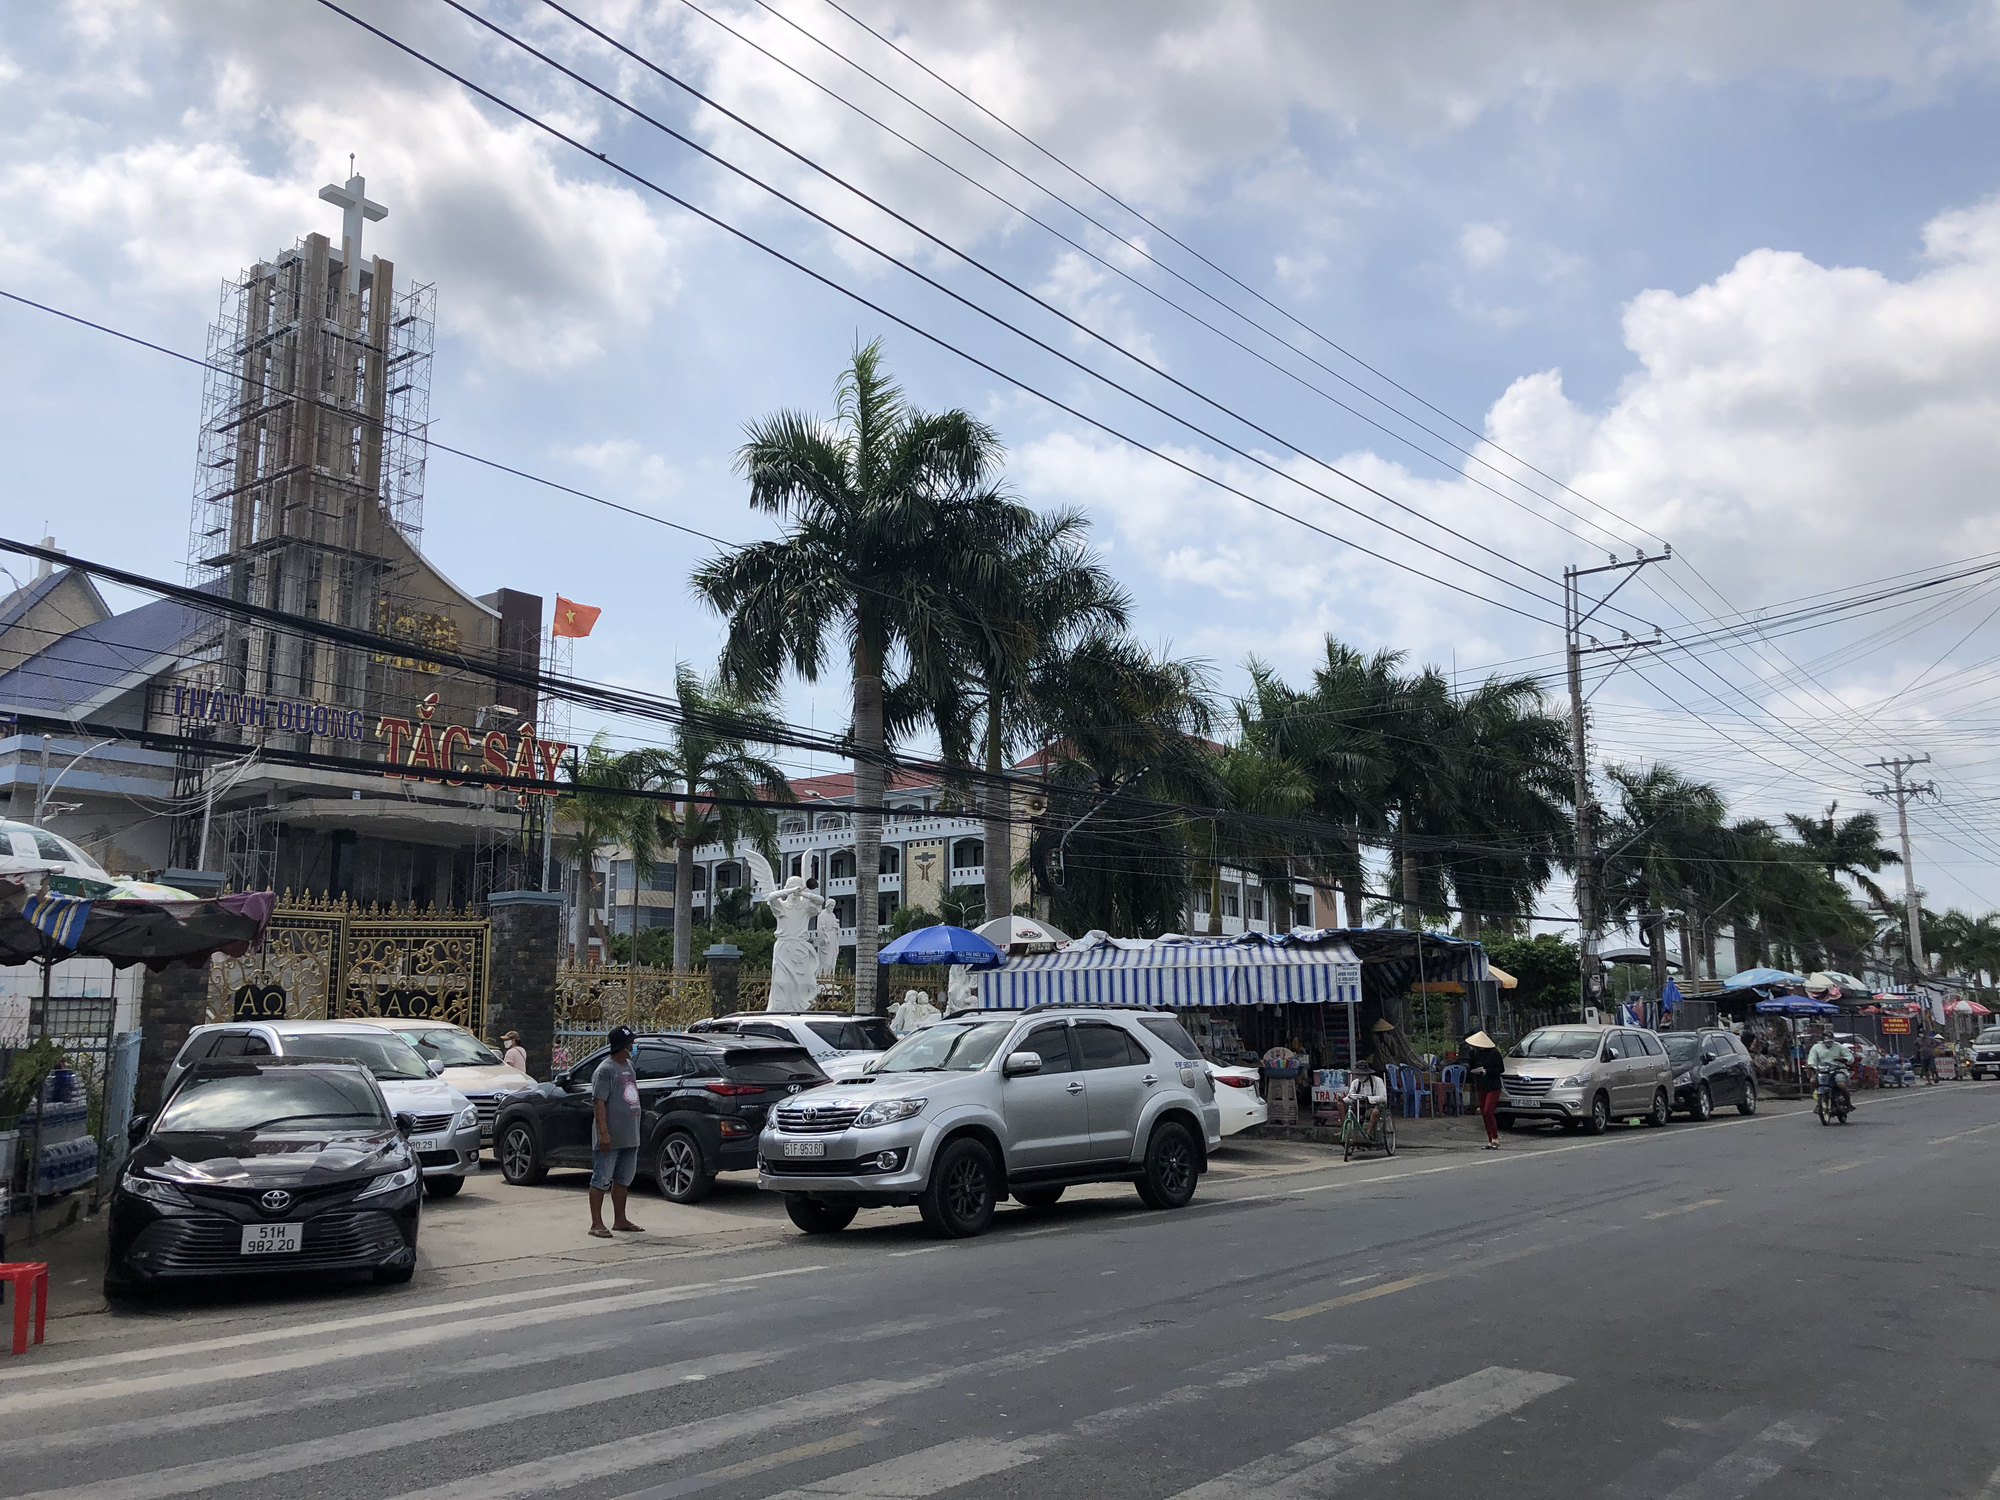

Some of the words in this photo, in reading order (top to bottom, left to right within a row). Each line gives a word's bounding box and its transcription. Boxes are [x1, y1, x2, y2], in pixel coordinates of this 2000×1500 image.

[375, 692, 472, 787] TẮC
[260, 1226, 286, 1239] 51H
[247, 1239, 295, 1252] 982.20
